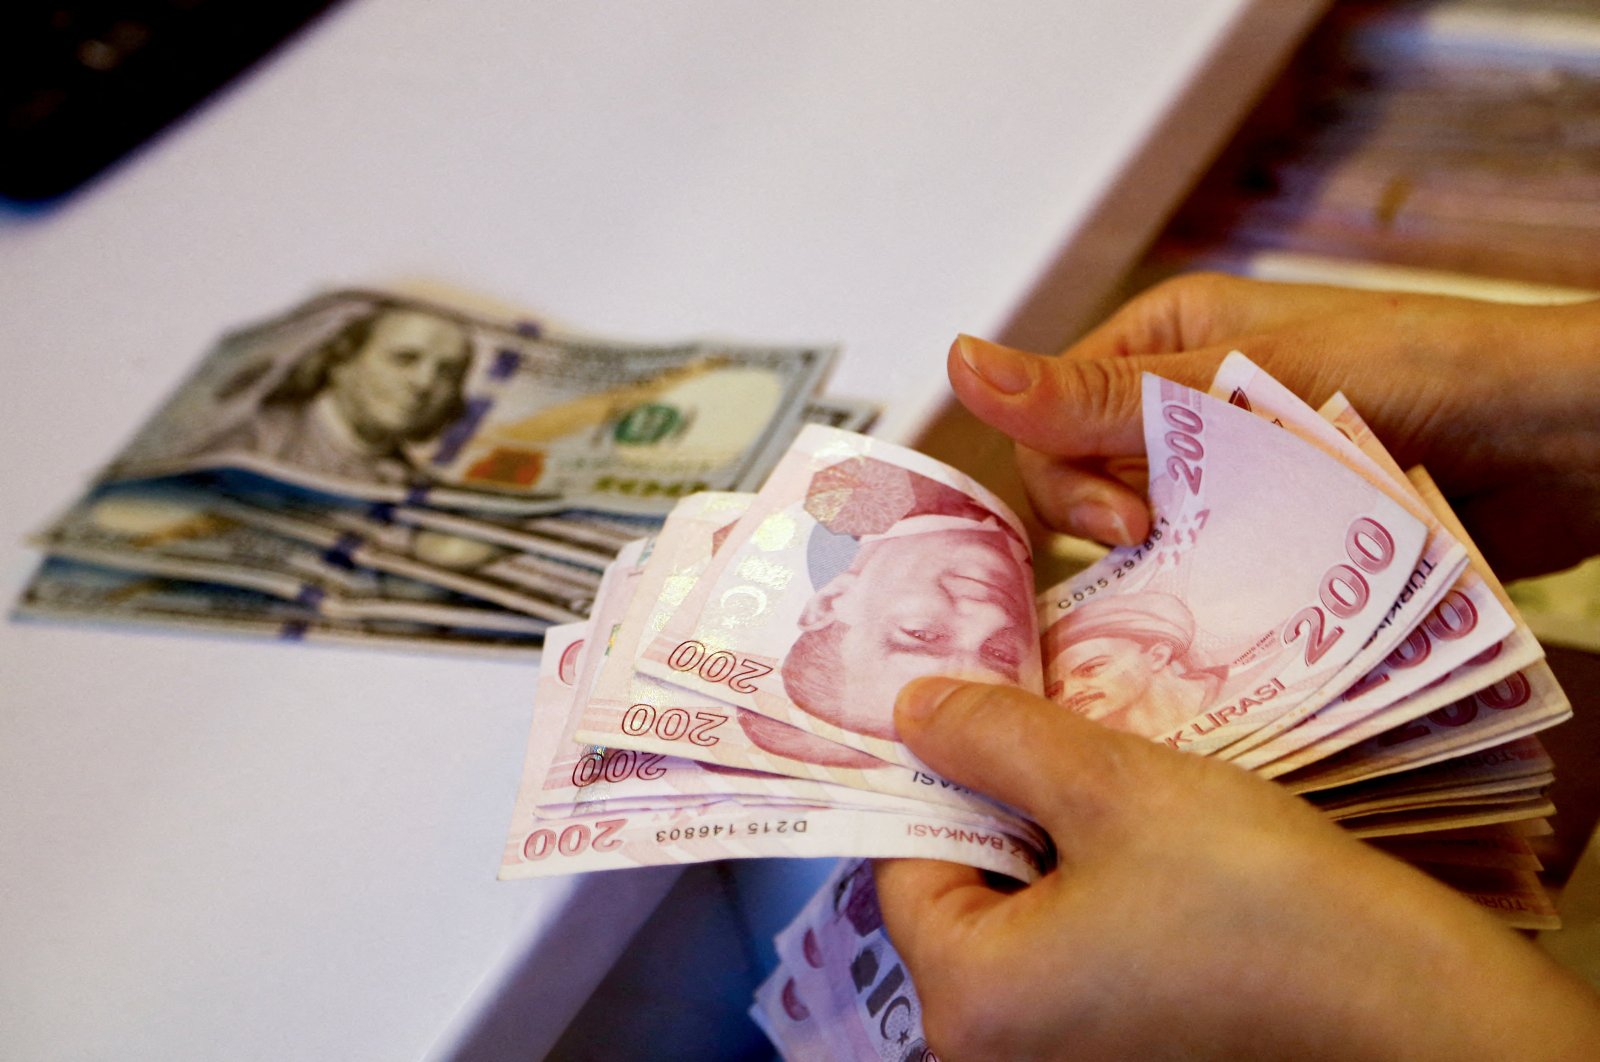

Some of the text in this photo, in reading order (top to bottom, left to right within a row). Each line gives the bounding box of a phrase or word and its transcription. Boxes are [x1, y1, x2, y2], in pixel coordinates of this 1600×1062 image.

[1163, 404, 1204, 496] 200
[1057, 577, 1109, 610] C035
[1283, 516, 1396, 668] 200
[667, 639, 774, 694] 200
[620, 703, 729, 747] 200
[571, 749, 668, 788] 200
[522, 817, 629, 862] 200
[655, 819, 808, 843] D215 146803
[907, 824, 1003, 850] BANKASI
